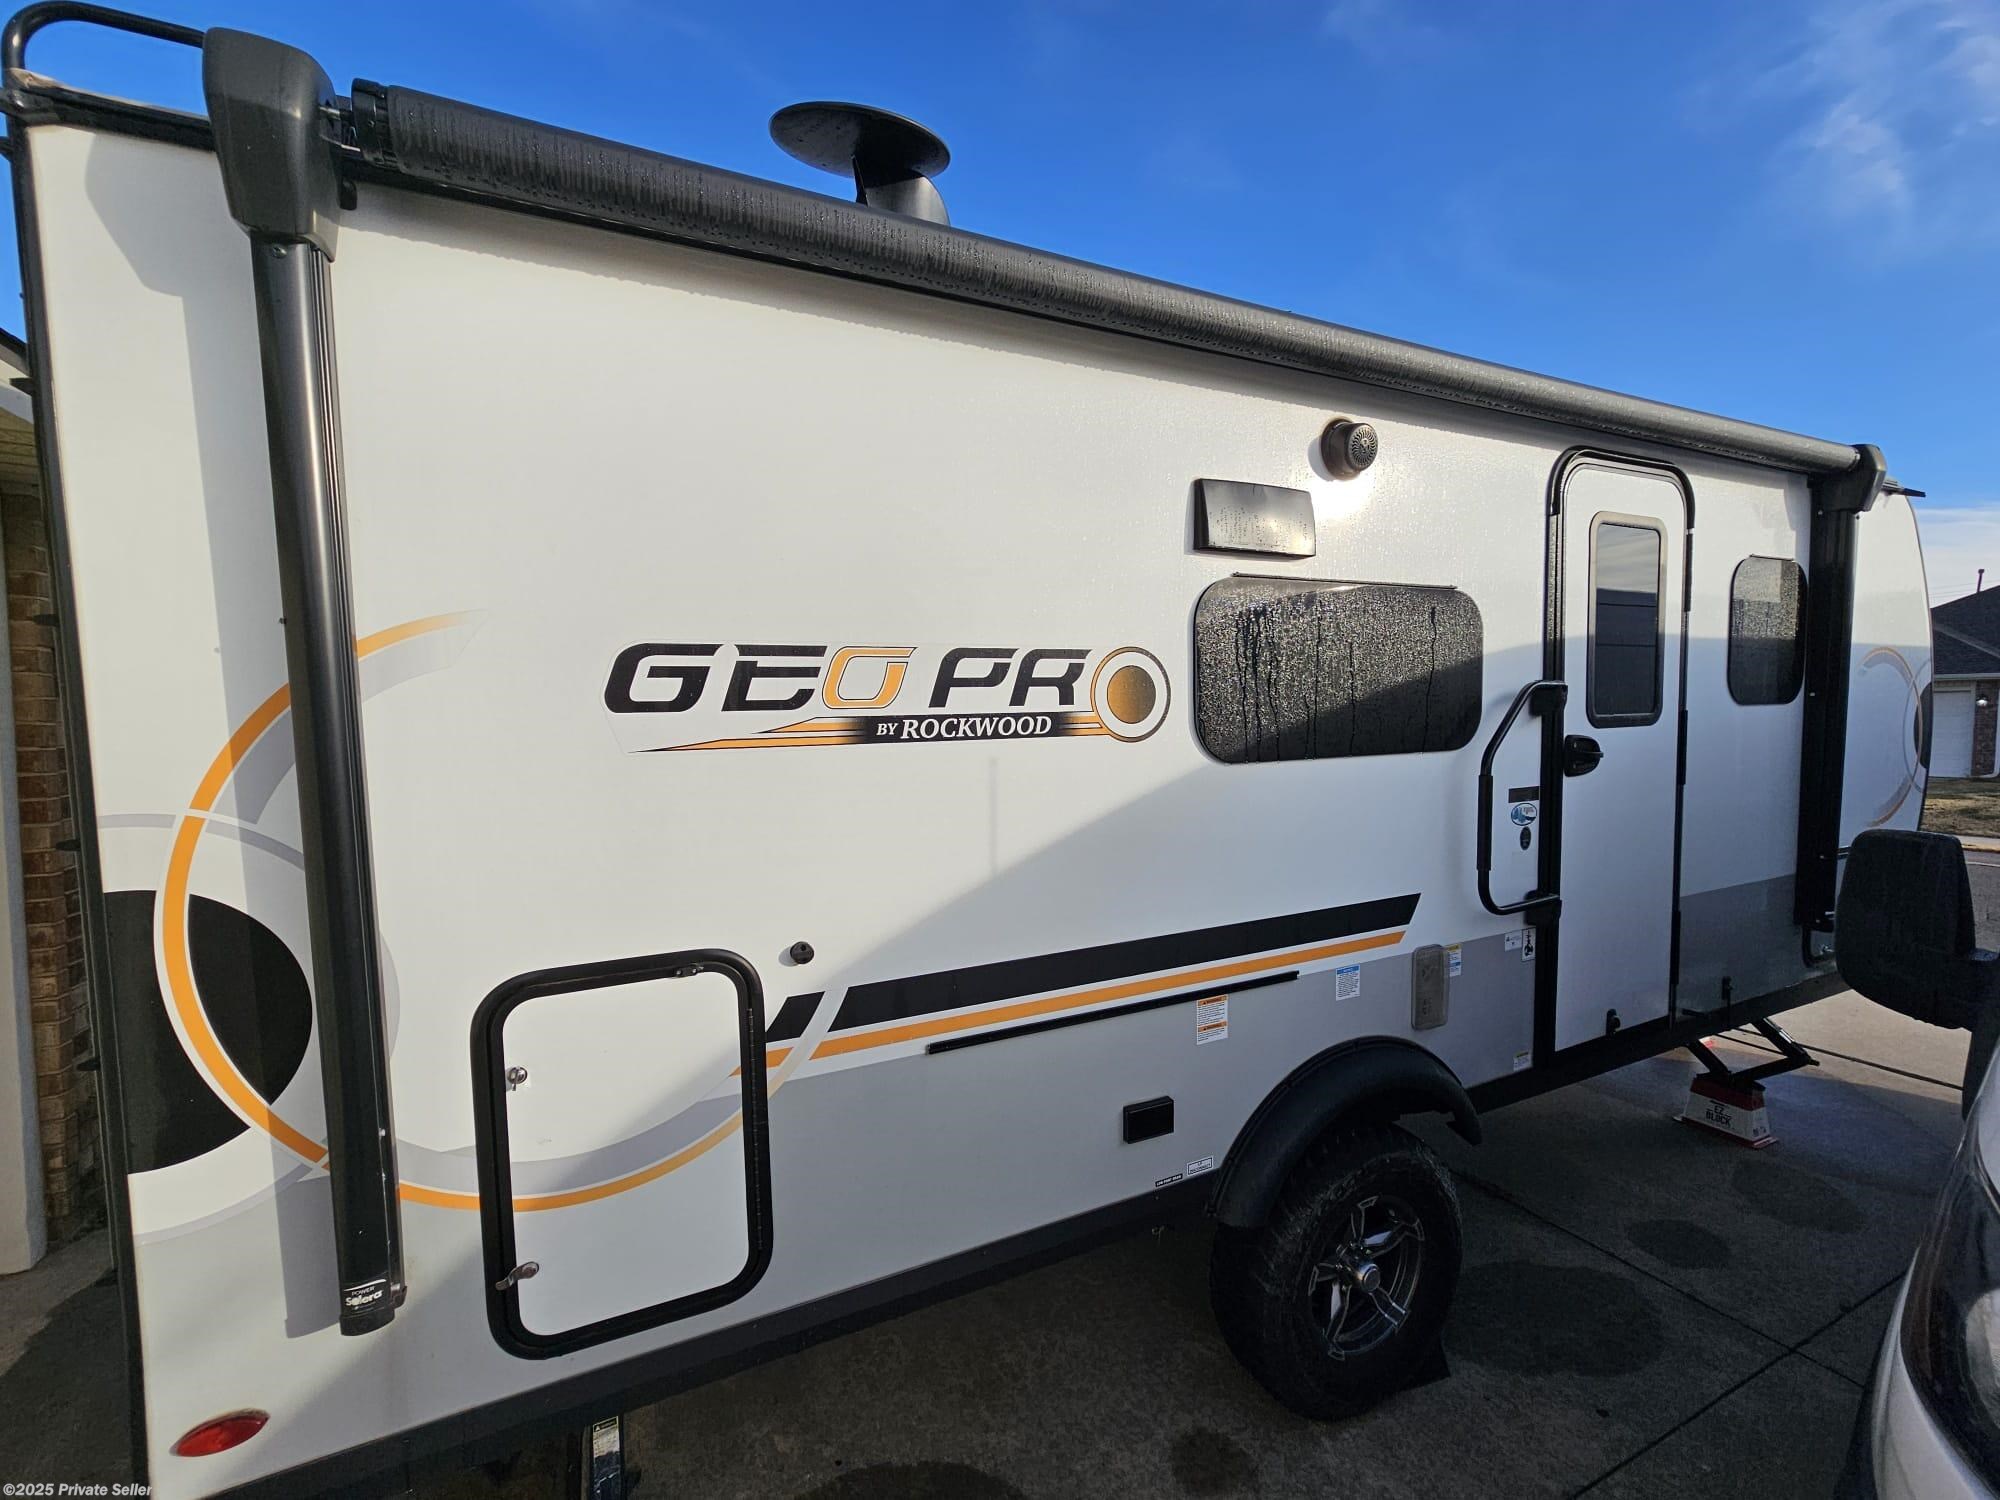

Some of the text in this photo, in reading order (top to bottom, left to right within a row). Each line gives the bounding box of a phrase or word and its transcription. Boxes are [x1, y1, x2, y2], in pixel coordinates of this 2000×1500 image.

[604, 643, 917, 714] GEO
[876, 715, 1053, 740] BY ROCKWOOD
[1705, 1110, 1732, 1126] BLOCK
[351, 1286, 375, 1296] POWER
